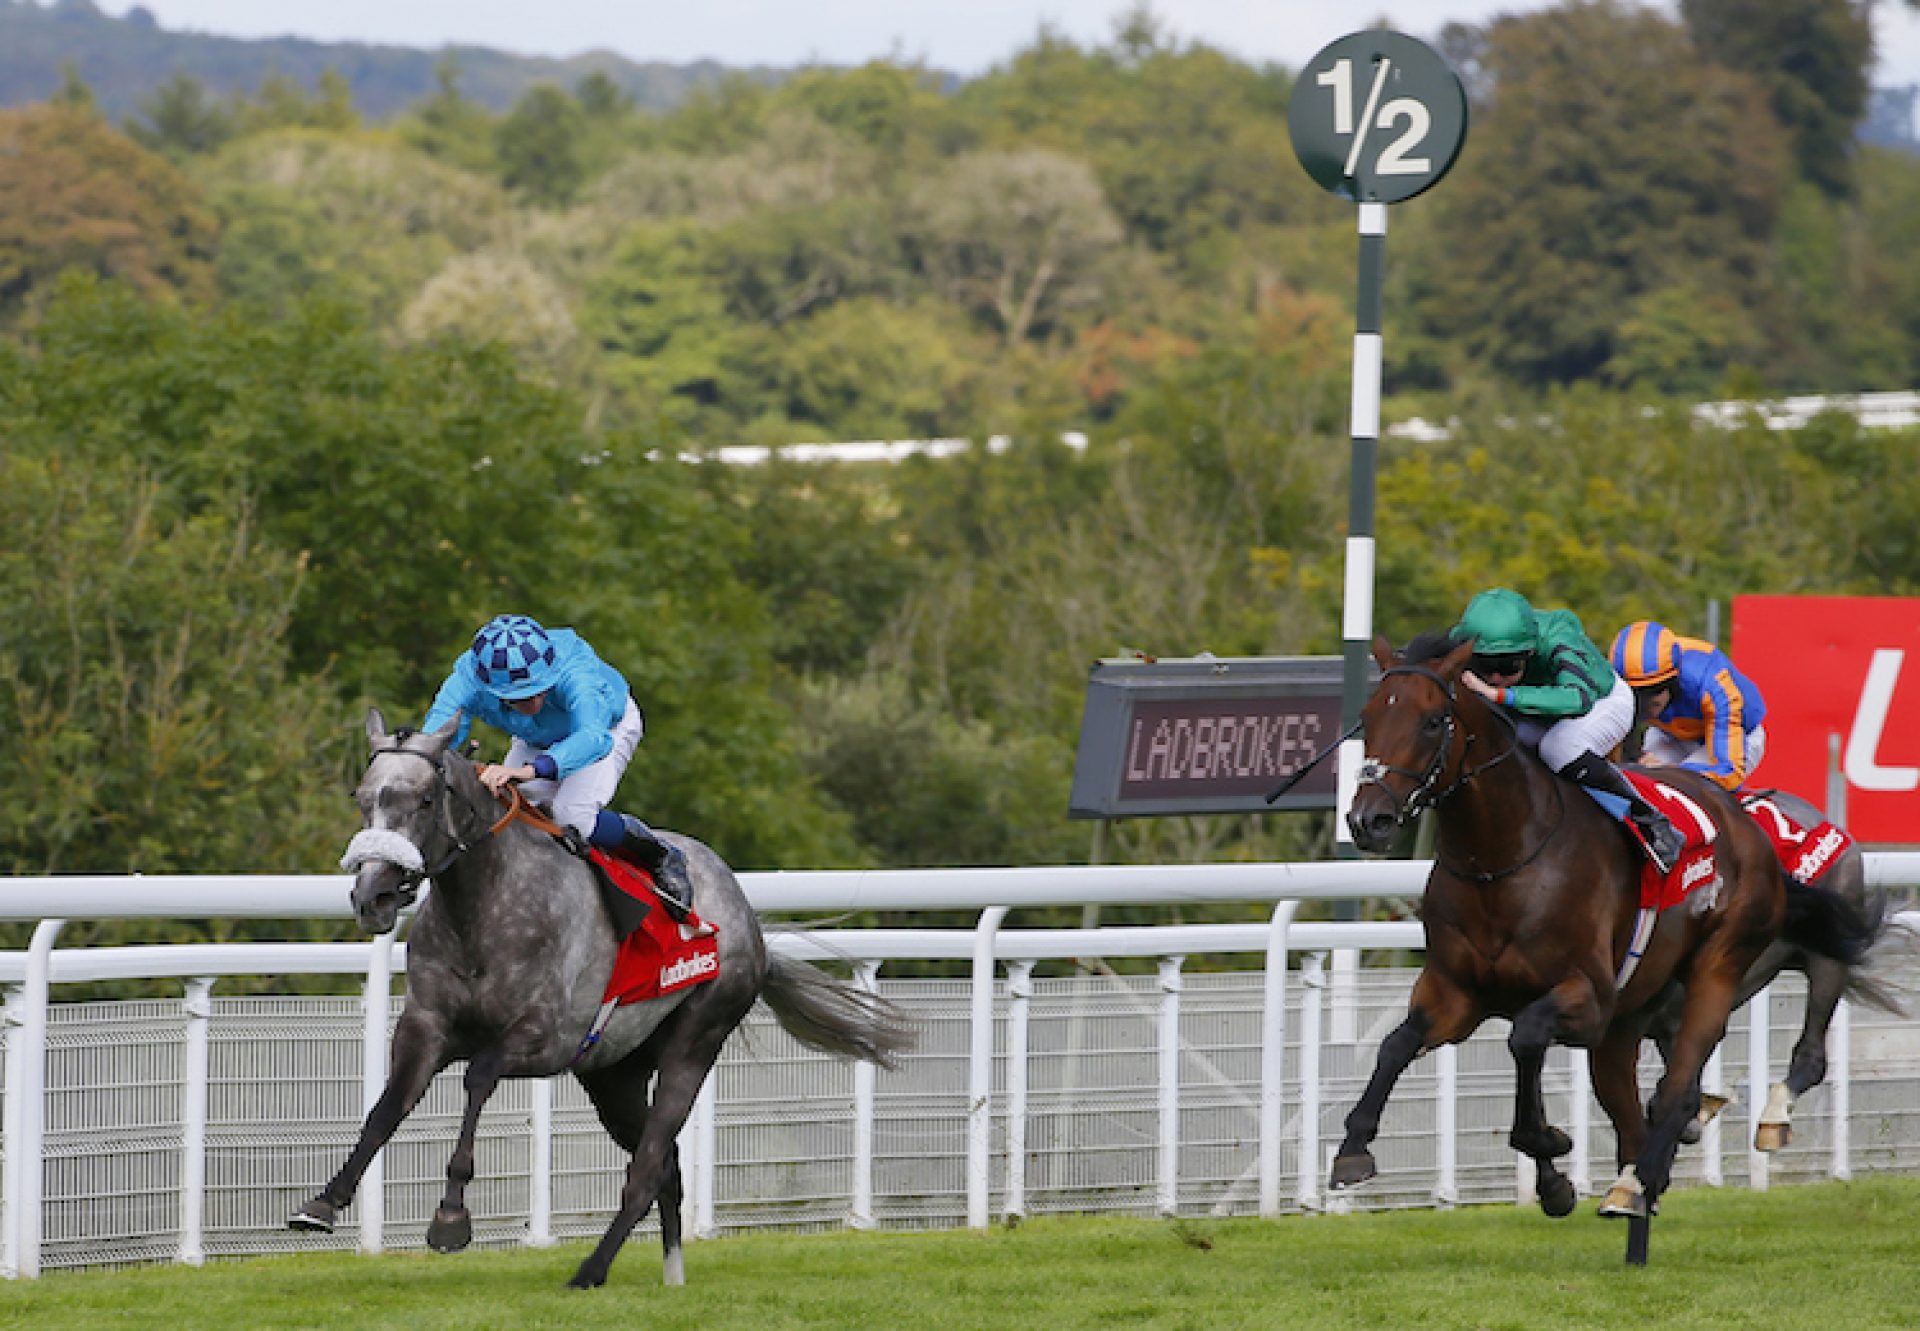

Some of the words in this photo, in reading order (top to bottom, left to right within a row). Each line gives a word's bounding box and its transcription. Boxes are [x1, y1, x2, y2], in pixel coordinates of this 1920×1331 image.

[1317, 58, 1431, 177] 1/2
[1127, 714, 1321, 781] LADBROKES
[1655, 783, 1717, 845] 1
[1741, 795, 1806, 842] 2
